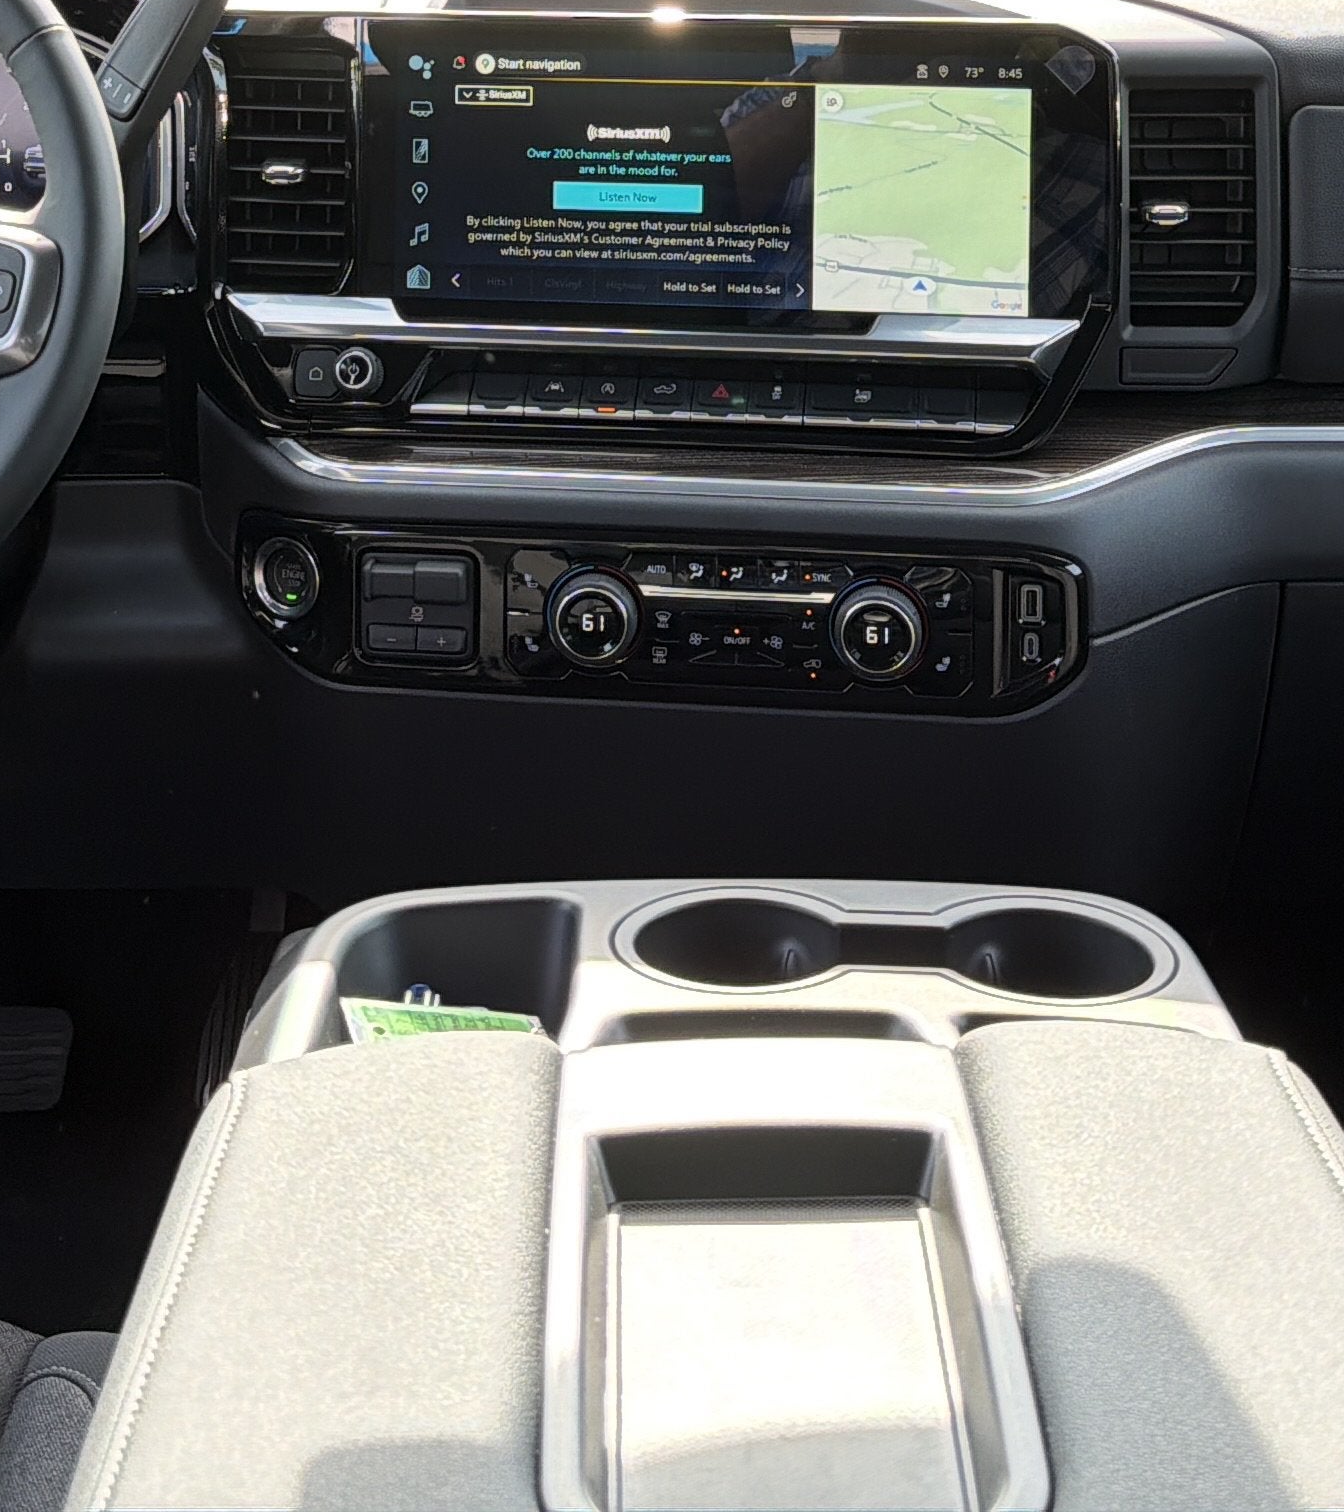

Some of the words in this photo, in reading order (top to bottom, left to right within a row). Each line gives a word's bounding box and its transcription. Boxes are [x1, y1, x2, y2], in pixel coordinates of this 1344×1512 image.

[497, 58, 524, 70] Start
[525, 58, 581, 72] navigation
[998, 68, 1022, 79] 8:45
[526, 148, 552, 158] Over
[553, 148, 574, 158] 200
[575, 149, 620, 160] channels
[622, 150, 635, 160] of
[636, 150, 682, 162] whatever
[683, 154, 706, 165] your
[708, 154, 732, 163] ears
[578, 166, 595, 174] are
[597, 166, 606, 174] in
[608, 166, 626, 175] the
[628, 166, 659, 176] mood
[660, 166, 678, 176] for.
[4, 182, 12, 192] 0
[599, 192, 630, 202] Listen
[632, 192, 657, 203] Now
[466, 216, 480, 228] By
[482, 216, 521, 228] clicking
[523, 217, 556, 228] Listen
[558, 218, 585, 229] Now,
[586, 220, 606, 231] you
[608, 221, 638, 232] agree
[640, 220, 662, 230] that
[664, 222, 688, 233] your
[690, 222, 712, 232] trial
[714, 222, 779, 235] subscription
[781, 224, 792, 234] is
[467, 231, 517, 243] governed
[520, 232, 532, 244] by
[591, 233, 643, 244] Customer
[645, 235, 704, 248] Agreement
[706, 237, 715, 247] &
[717, 238, 755, 250] Privacy
[758, 238, 790, 251] Policy
[500, 246, 531, 256] which
[532, 248, 552, 258] you
[556, 249, 573, 258] can
[574, 248, 599, 258] view
[601, 250, 612, 258] at
[614, 249, 756, 264] siriusxm.com/agreements.
[664, 282, 687, 292] Hold
[688, 283, 699, 292] to
[700, 283, 716, 293] Set
[728, 284, 750, 293] Hold
[752, 284, 763, 294] to
[765, 284, 780, 294] Set
[991, 299, 1022, 310] Google
[646, 564, 666, 574] AUTO
[812, 574, 832, 582] SYNC
[582, 614, 604, 632] 61
[802, 622, 816, 630] A/C
[866, 626, 889, 644] 61
[723, 636, 751, 646] ON/OFF
